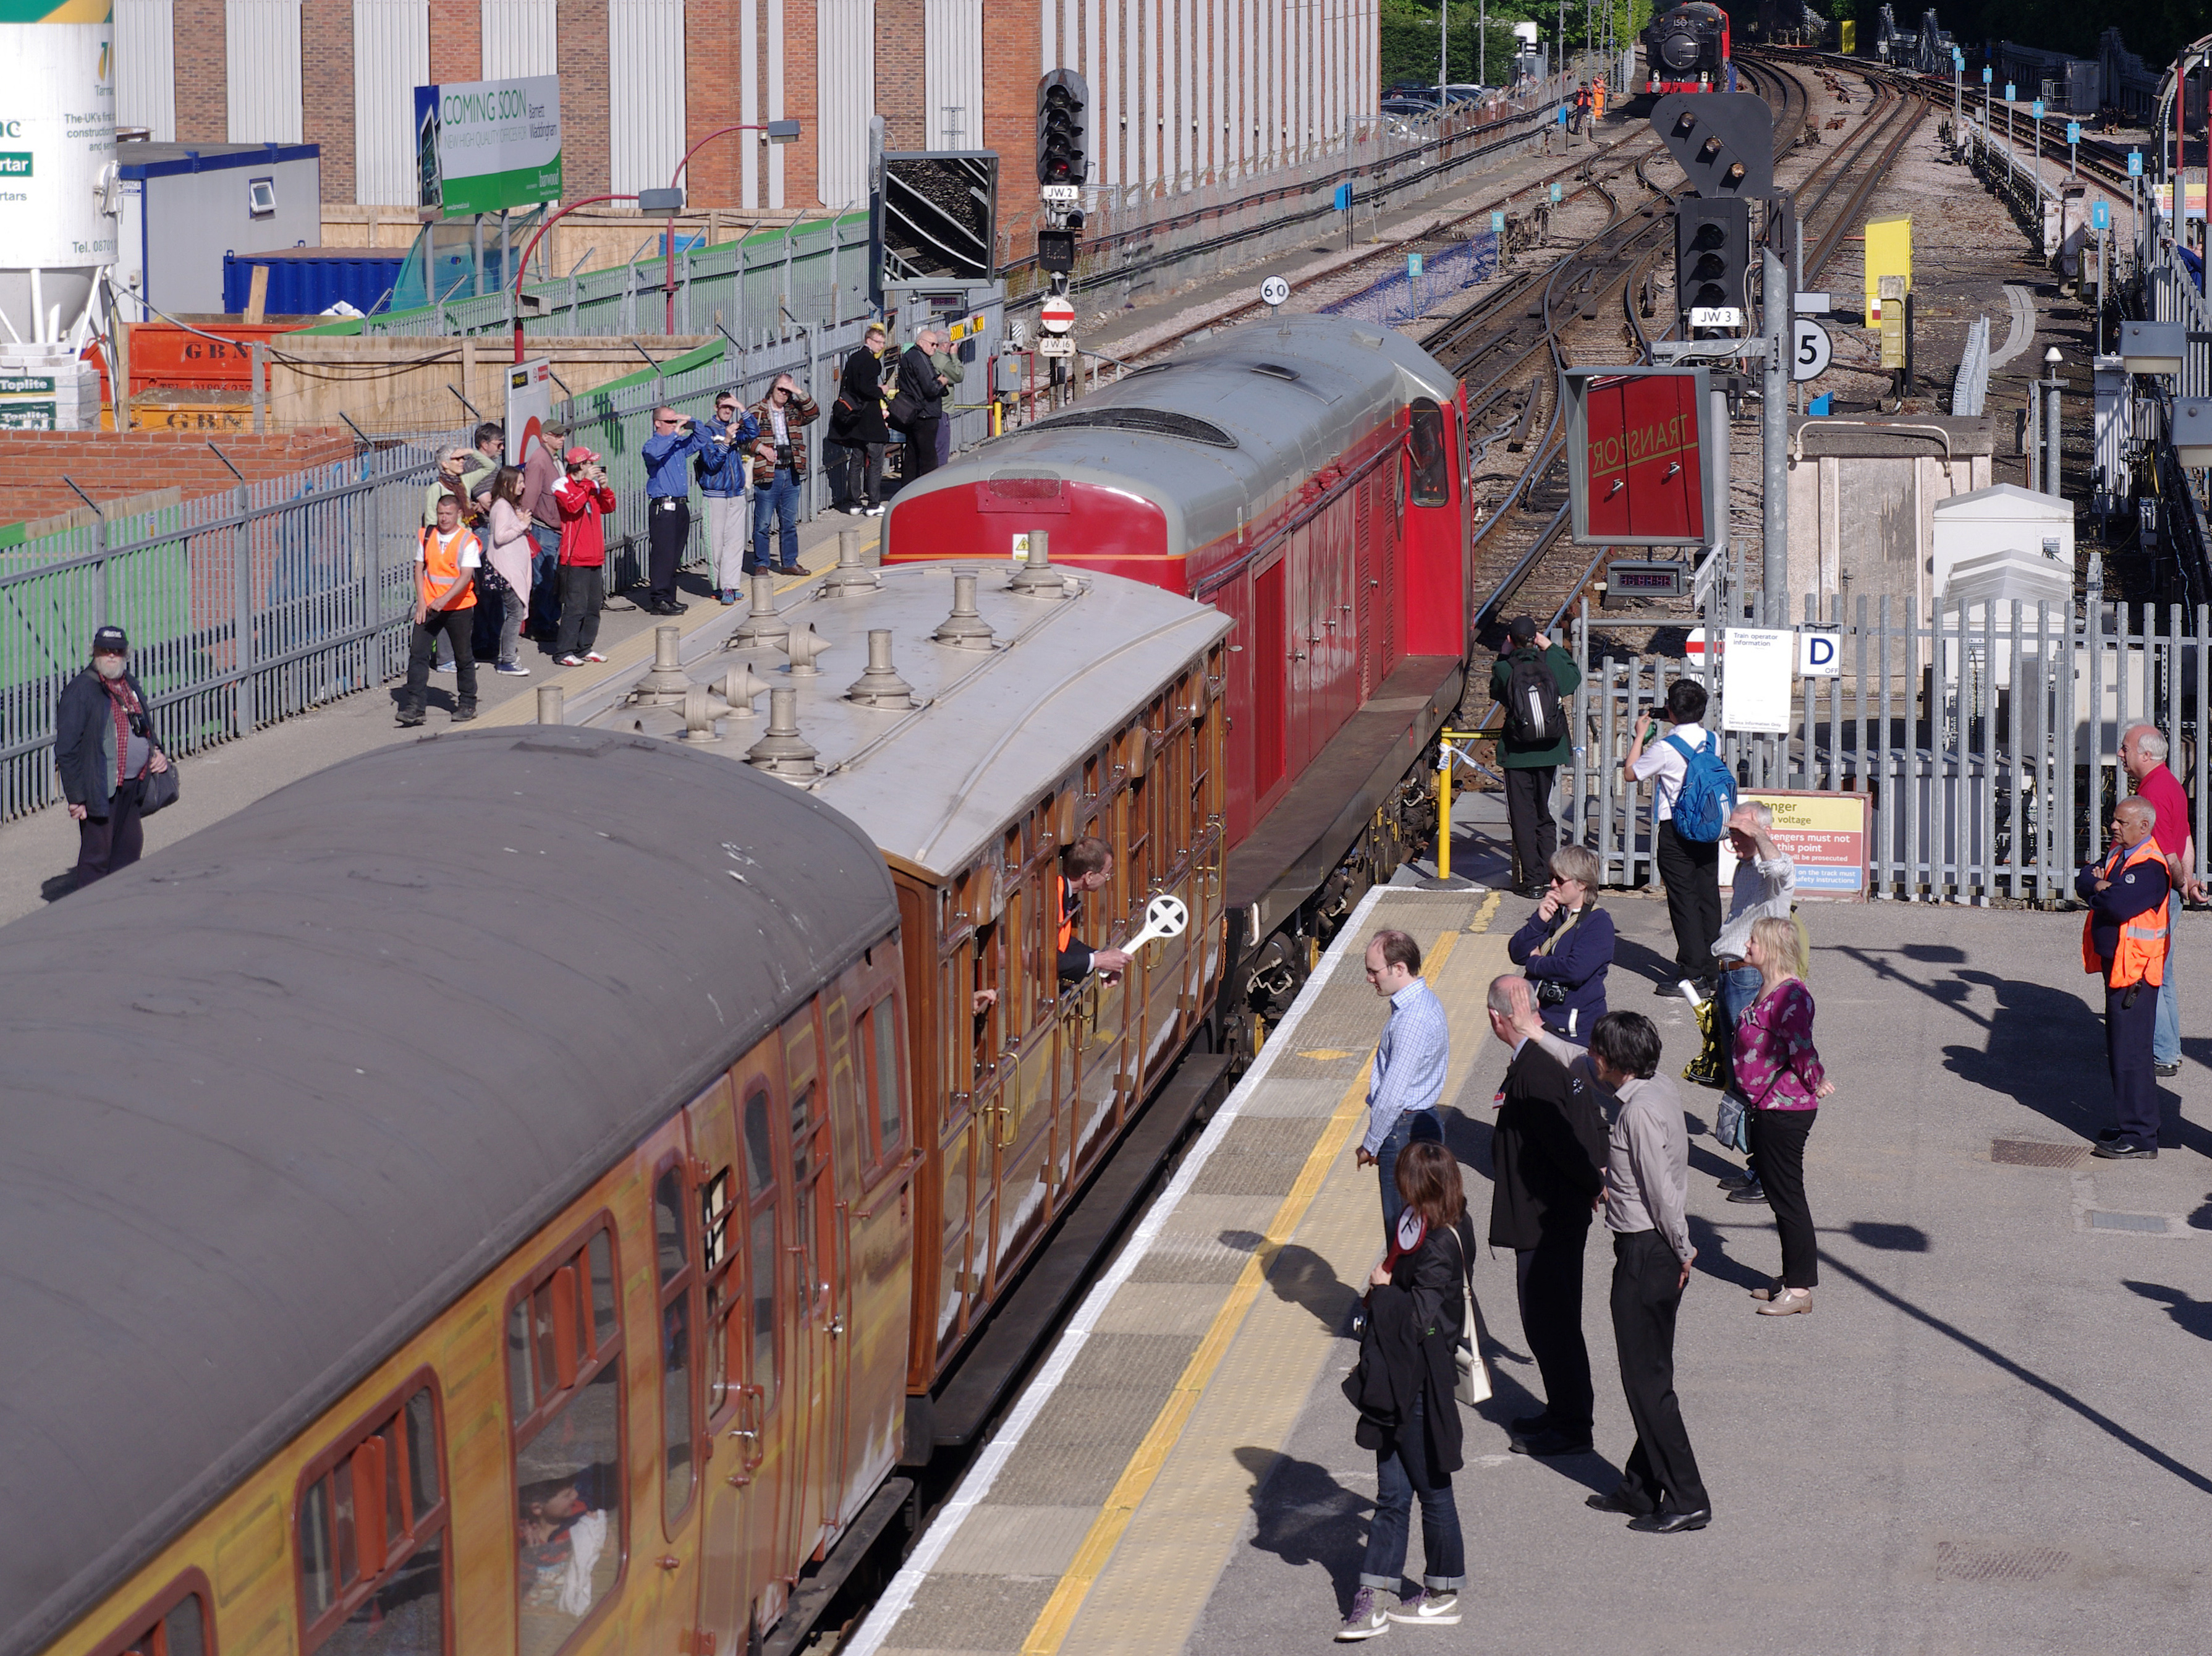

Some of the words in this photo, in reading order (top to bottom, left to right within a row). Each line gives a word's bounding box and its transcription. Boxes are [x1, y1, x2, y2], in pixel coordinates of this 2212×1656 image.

[444, 92, 495, 125] COMING
[499, 88, 527, 120] SOON
[64, 114, 82, 124] The
[85, 112, 101, 122] UK's
[2070, 128, 2077, 138] 3
[89, 141, 103, 151] and
[2132, 159, 2139, 171] 2
[1049, 188, 1073, 198] JW.2
[1553, 188, 1560, 197] 4
[2098, 208, 2104, 222] 1
[1494, 216, 1502, 227] 3
[72, 242, 91, 253] Tel.
[1412, 260, 1420, 271] 2
[1264, 285, 1286, 297] 60
[1701, 312, 1721, 322] JW
[1726, 311, 1731, 322] 3
[1798, 335, 1818, 365] 5
[0, 379, 48, 392] Toplite
[1751, 633, 1778, 641] operator
[1810, 637, 1834, 665] D
[1778, 816, 1812, 825] voltage
[1769, 833, 1805, 843] sengers
[1807, 834, 1831, 843] must
[1777, 843, 1795, 851] this
[1797, 844, 1823, 852] point
